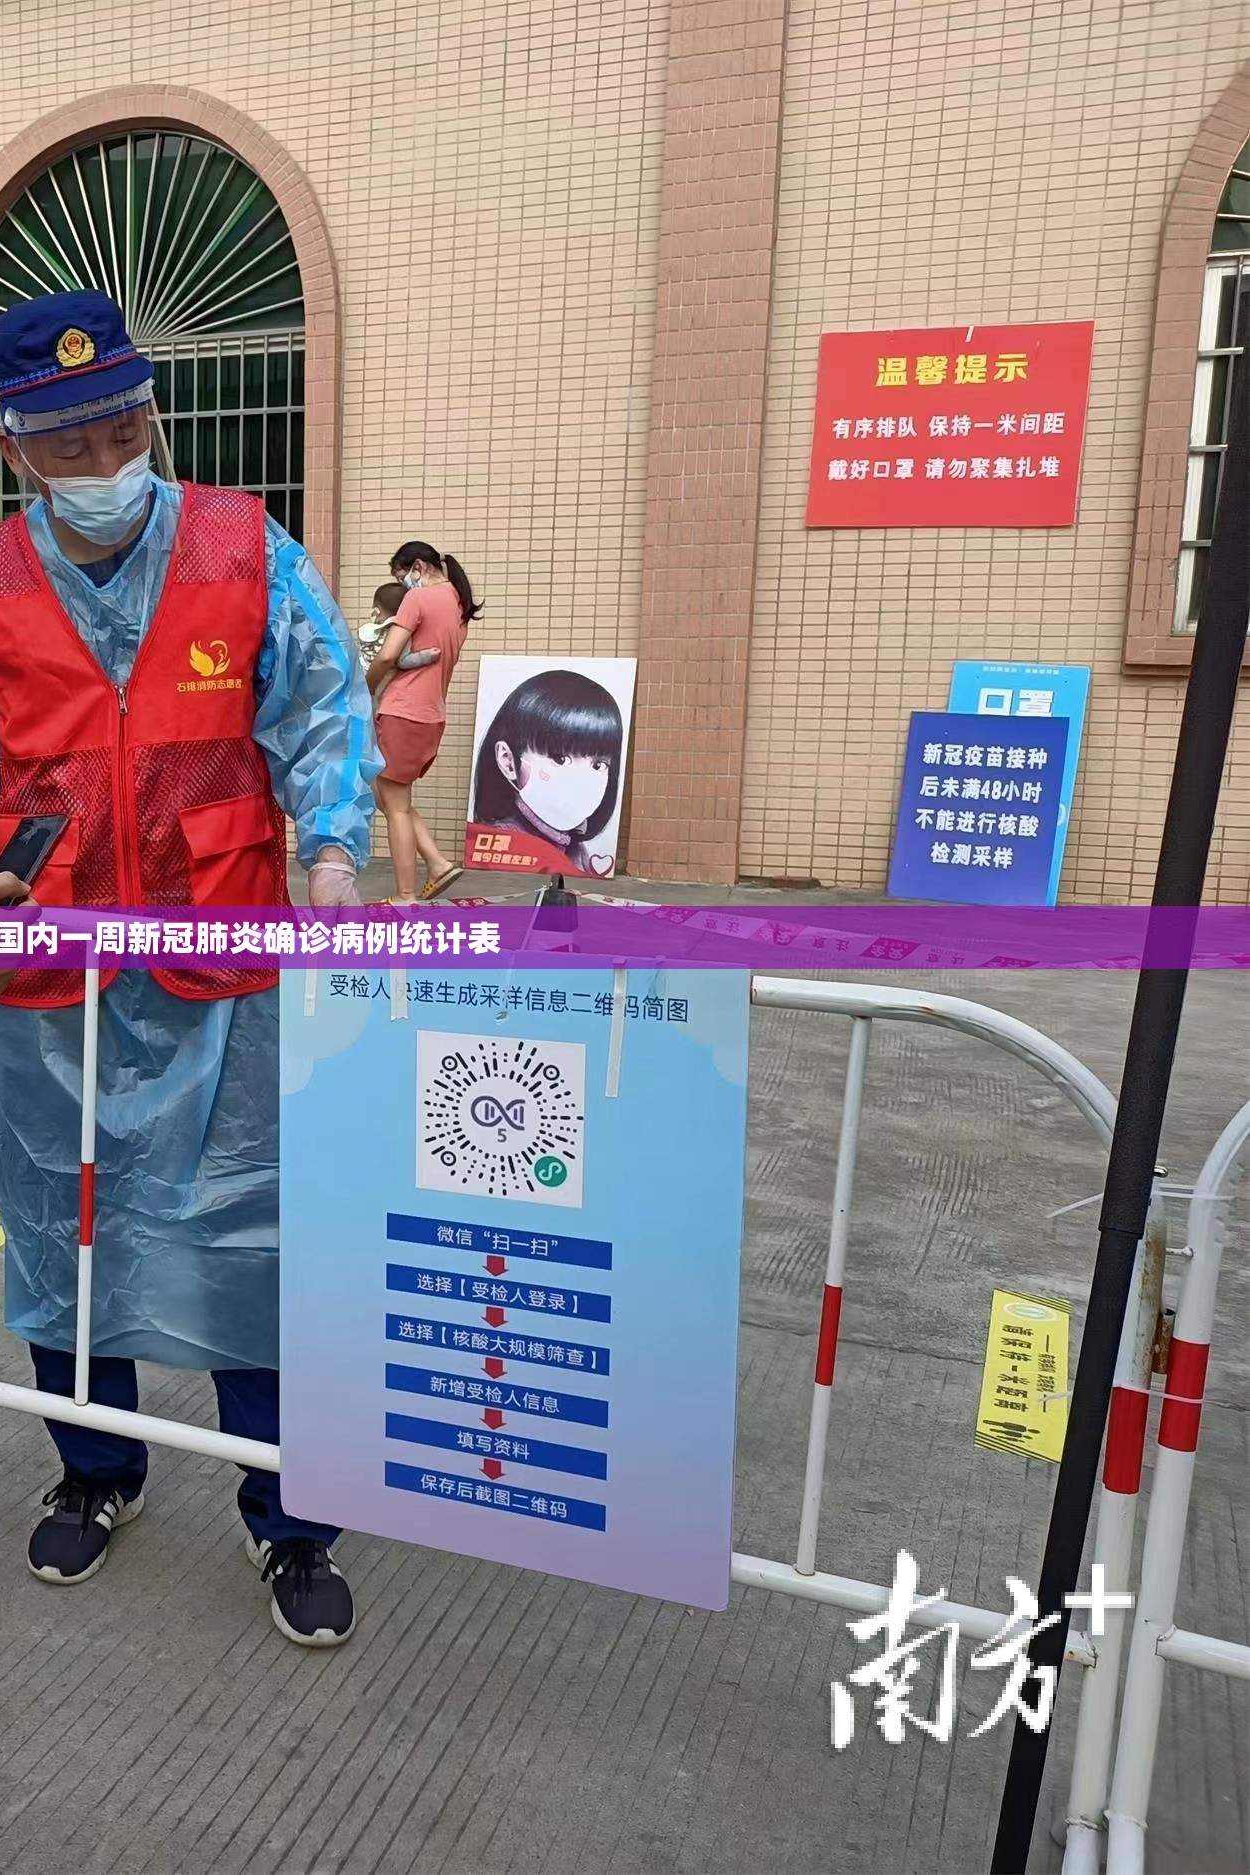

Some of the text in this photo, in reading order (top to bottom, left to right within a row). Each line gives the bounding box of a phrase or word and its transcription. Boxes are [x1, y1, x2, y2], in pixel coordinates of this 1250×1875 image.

[875, 353, 1029, 387] 温馨提示
[831, 412, 1066, 439] 有序排队 保持一米间距
[827, 456, 1061, 481] 戴好口罩 请勿聚集扎堆
[977, 687, 1055, 717] 口罩
[922, 742, 1048, 770] 新冠疫苗接种
[919, 775, 1043, 804] 后未满48小时
[914, 808, 1039, 837] 不能进行核酸
[474, 833, 512, 851] 口罩
[930, 841, 1014, 869] 检测采样
[430, 1375, 560, 1414] 新增受检人信息
[457, 1431, 530, 1460] 填写资料
[420, 1473, 568, 1519] 保存后截图二维码
